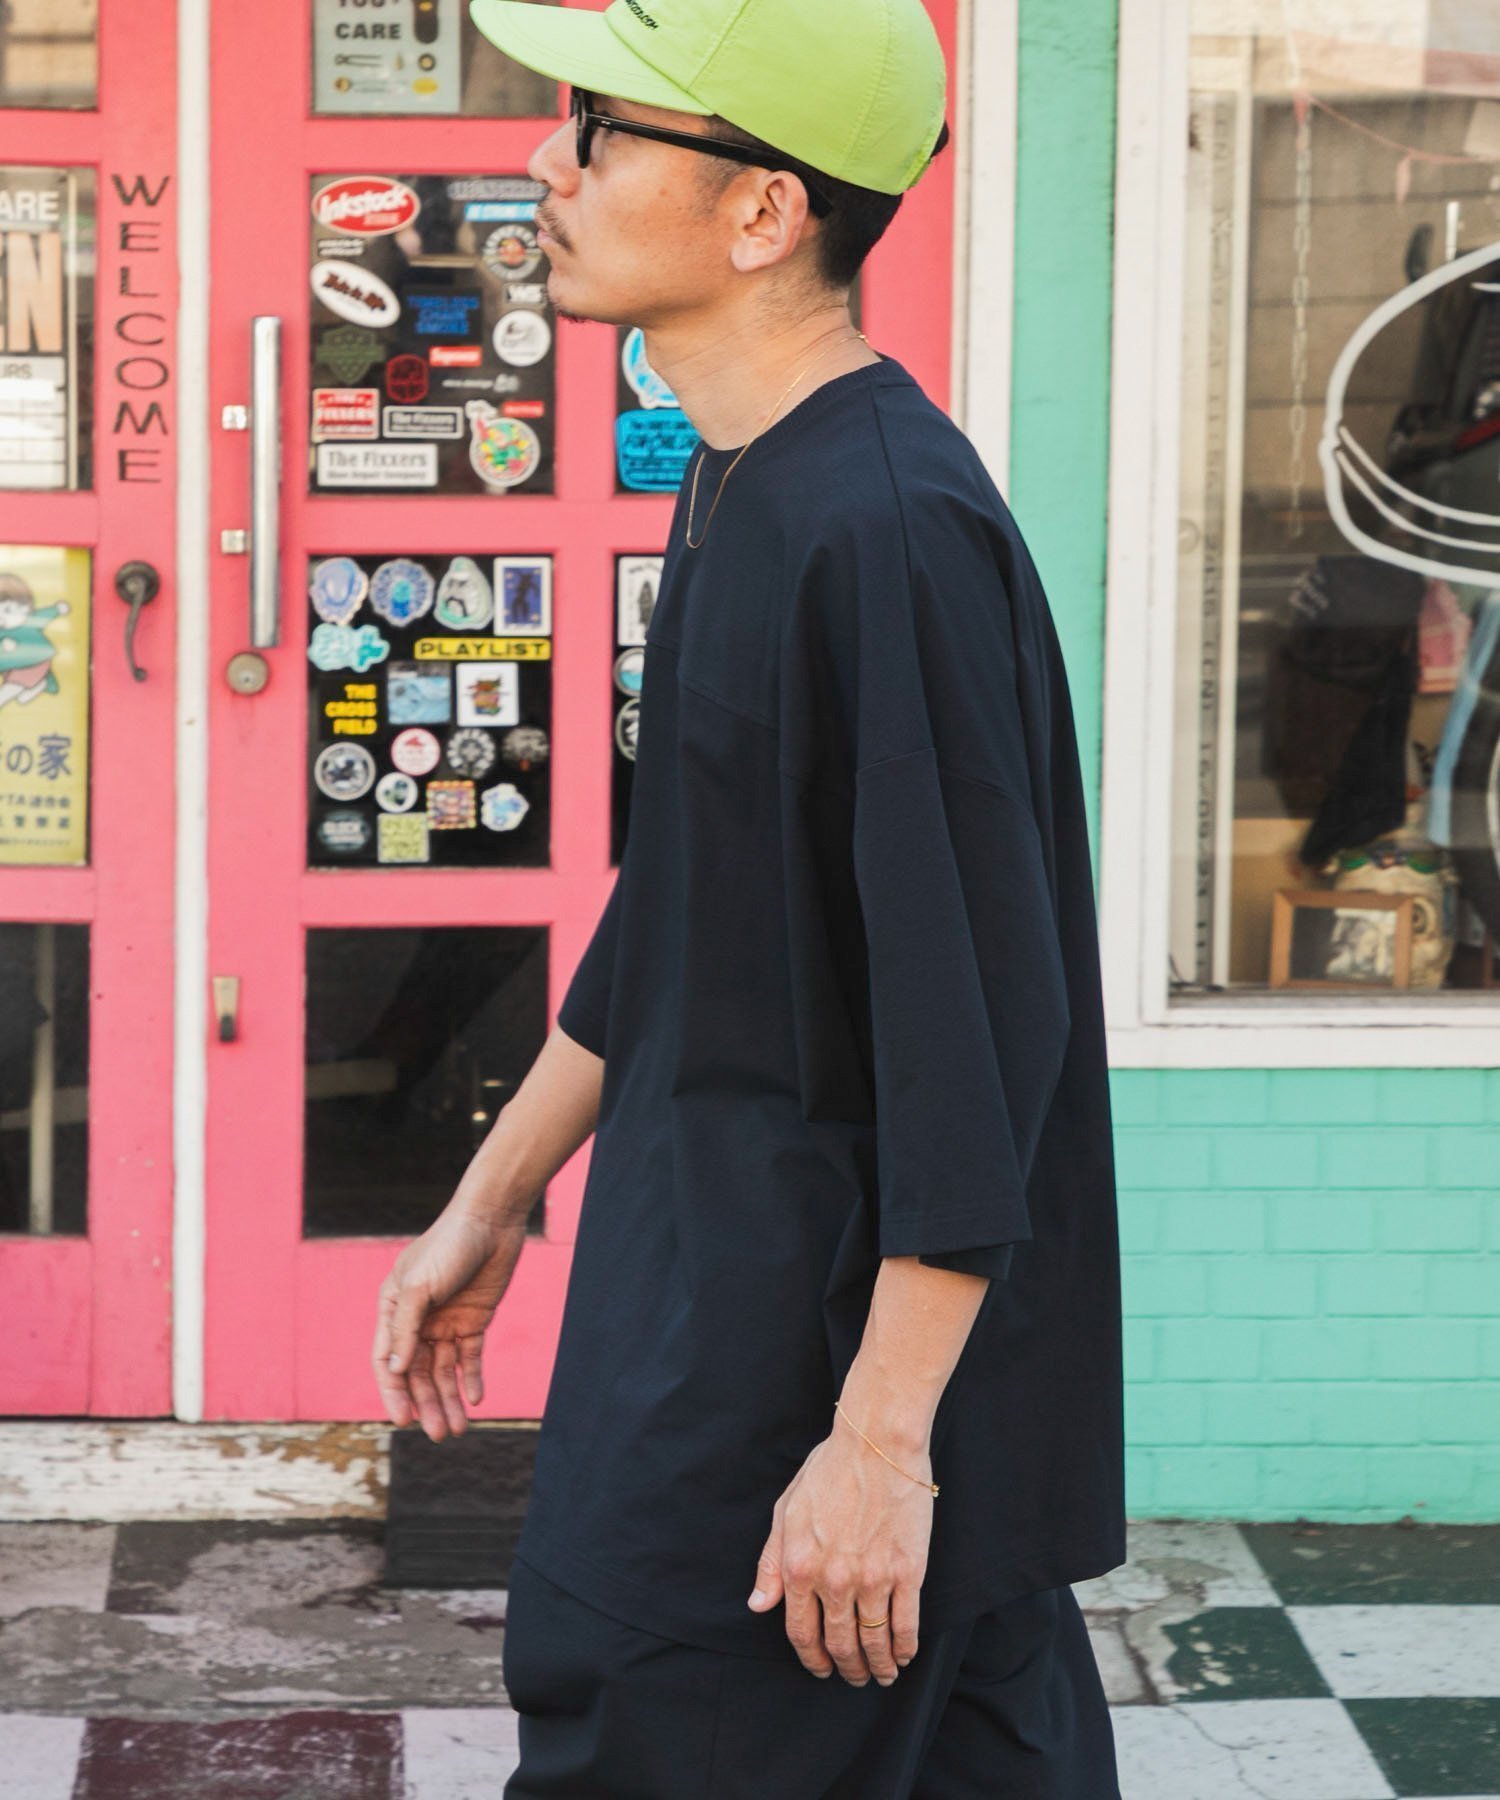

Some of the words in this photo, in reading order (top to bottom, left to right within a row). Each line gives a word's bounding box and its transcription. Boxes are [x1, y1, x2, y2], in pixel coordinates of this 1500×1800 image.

[335, 23, 401, 39] CARE
[112, 174, 170, 483] WELCOME
[420, 642, 546, 657] PLAYLIST
[325, 701, 377, 718] CROSS
[333, 718, 378, 735] FIELD
[0, 733, 71, 780] の家
